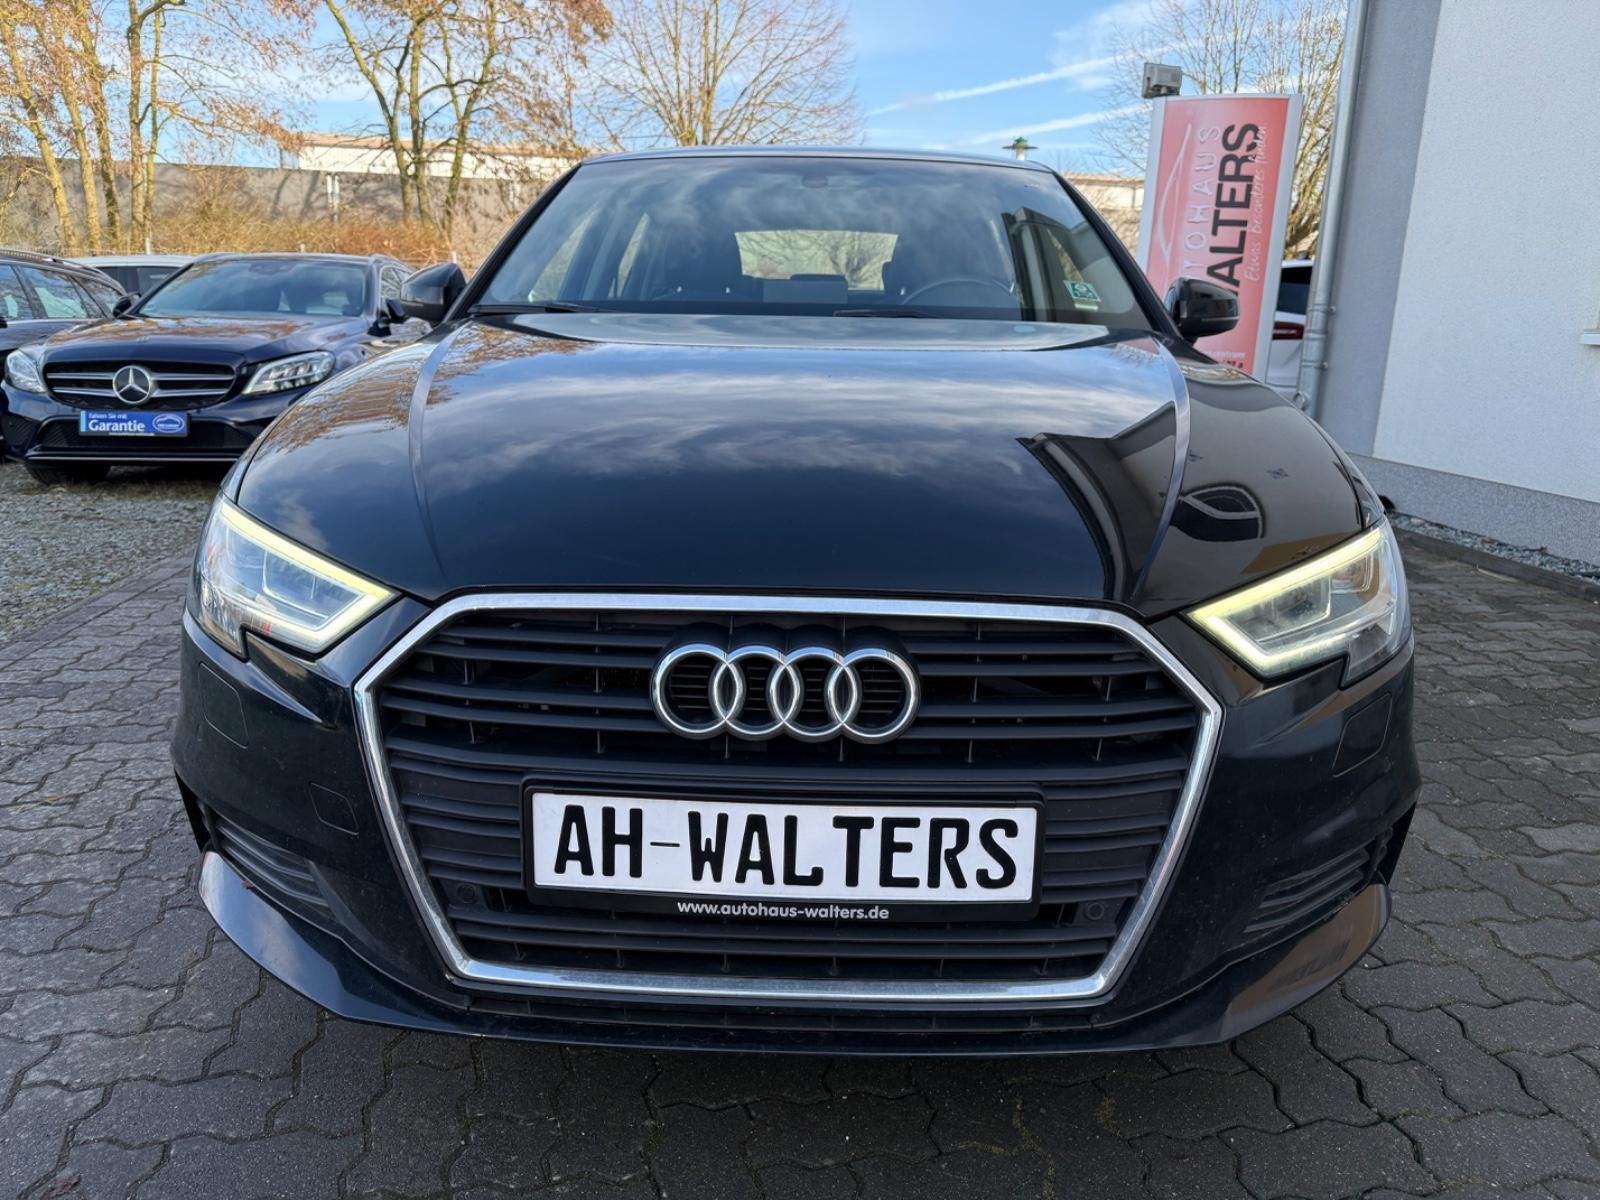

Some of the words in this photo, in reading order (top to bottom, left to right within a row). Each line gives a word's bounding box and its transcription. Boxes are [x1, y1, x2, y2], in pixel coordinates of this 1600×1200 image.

[1247, 125, 1268, 164] finden
[1181, 126, 1221, 271] TOHAUS
[1206, 122, 1260, 296] ALTERS
[88, 419, 146, 432] Garantie
[677, 902, 890, 919] www.autohaus-walters.de
